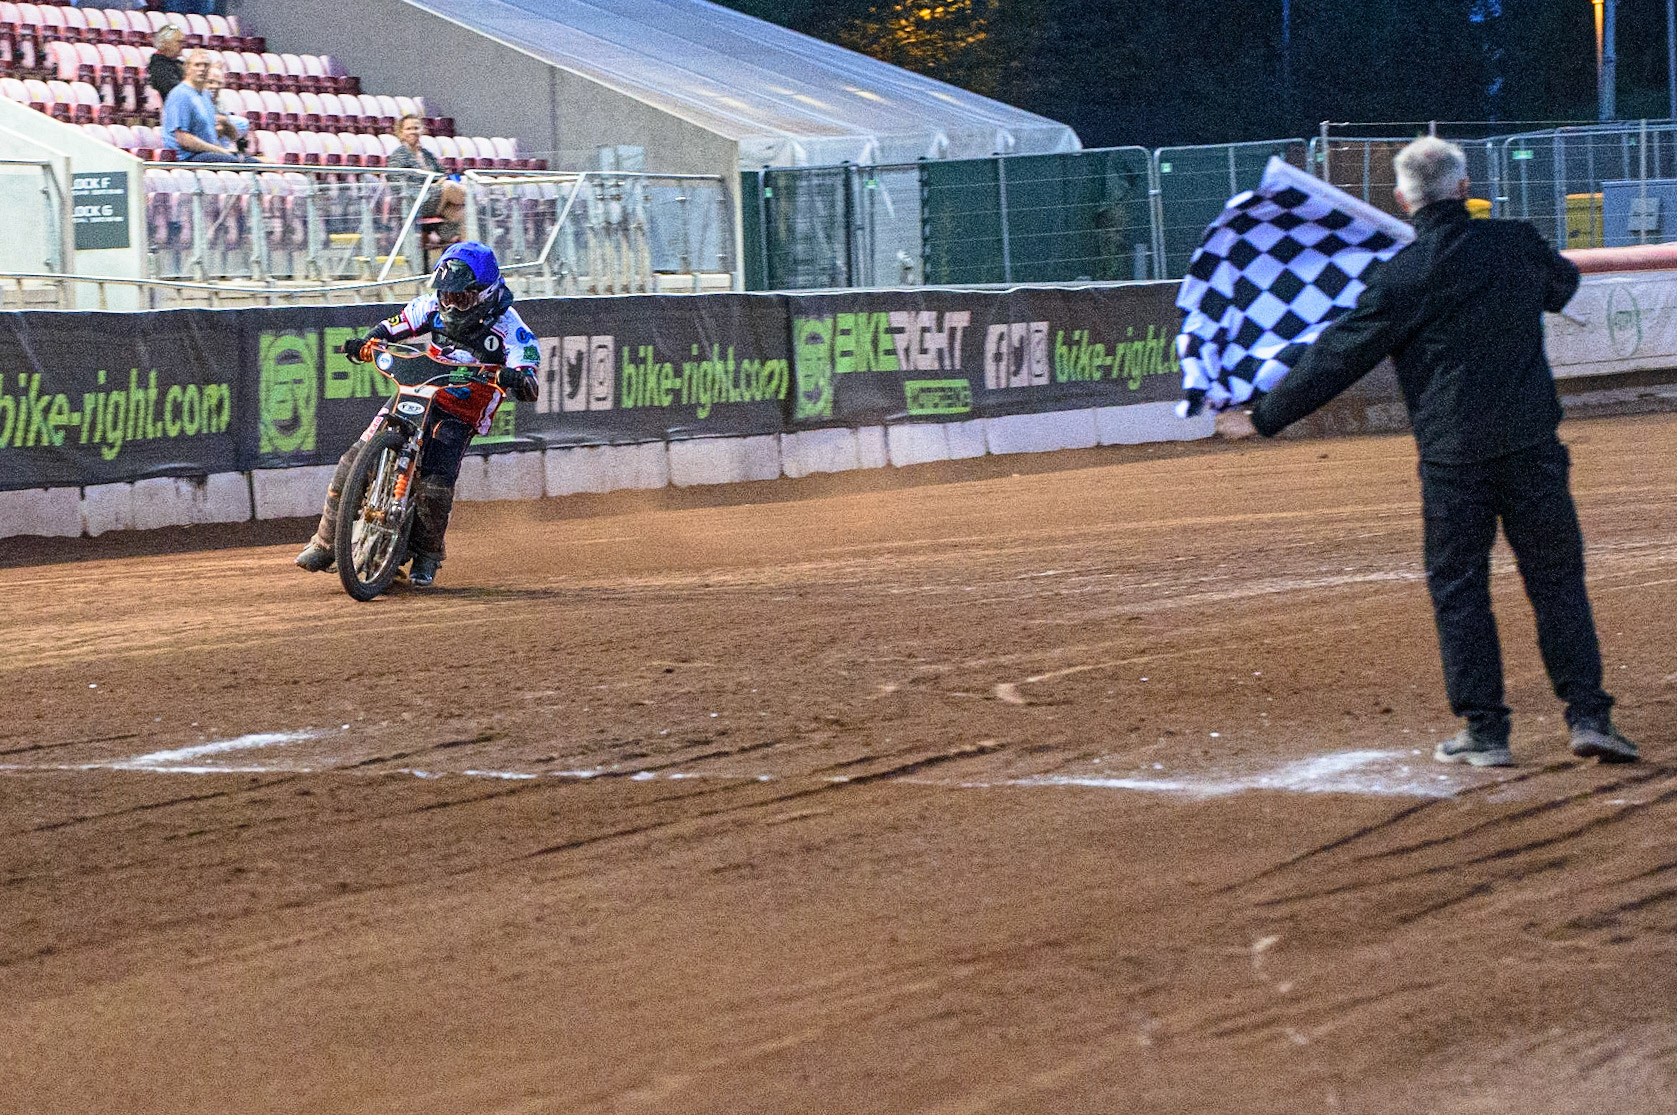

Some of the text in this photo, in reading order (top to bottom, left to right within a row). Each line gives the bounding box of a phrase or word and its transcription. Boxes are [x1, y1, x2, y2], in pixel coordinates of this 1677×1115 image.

[101, 177, 112, 188] F
[488, 337, 495, 350] 1
[621, 343, 789, 419] bike-right.com
